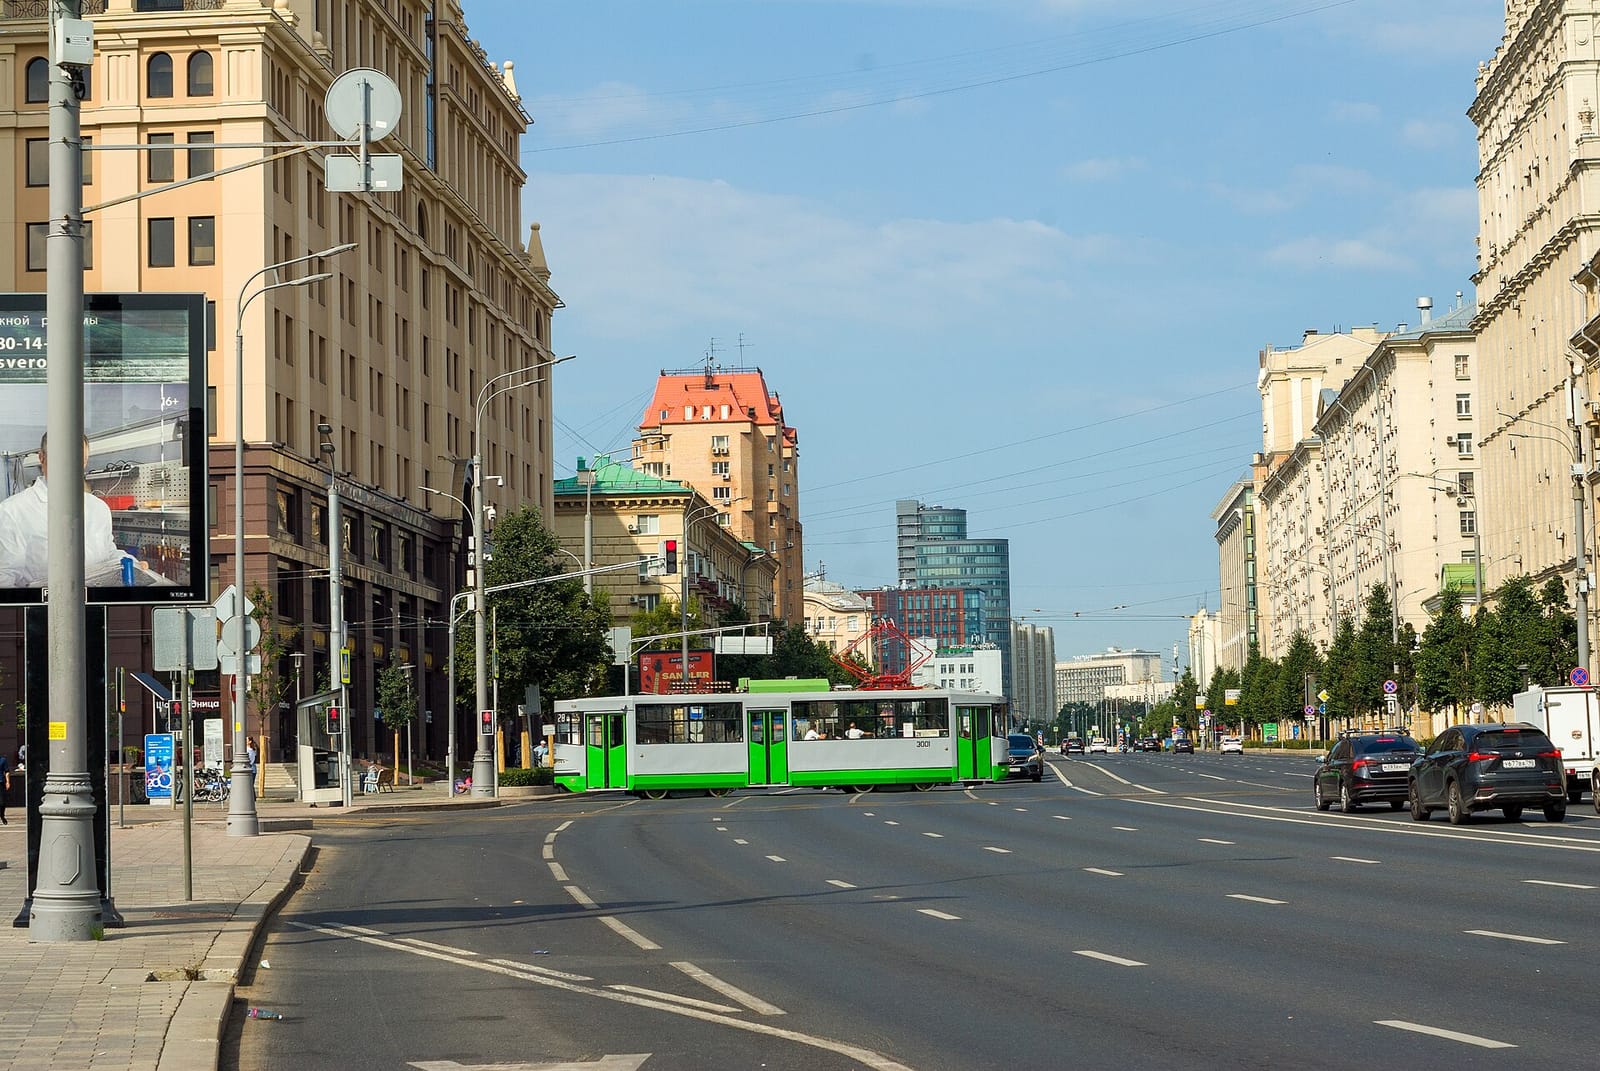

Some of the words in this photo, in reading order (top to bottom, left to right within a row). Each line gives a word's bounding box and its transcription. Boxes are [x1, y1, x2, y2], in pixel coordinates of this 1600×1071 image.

[662, 671, 710, 680] SANLER
[557, 713, 566, 723] 28
[916, 740, 931, 748] 3001
